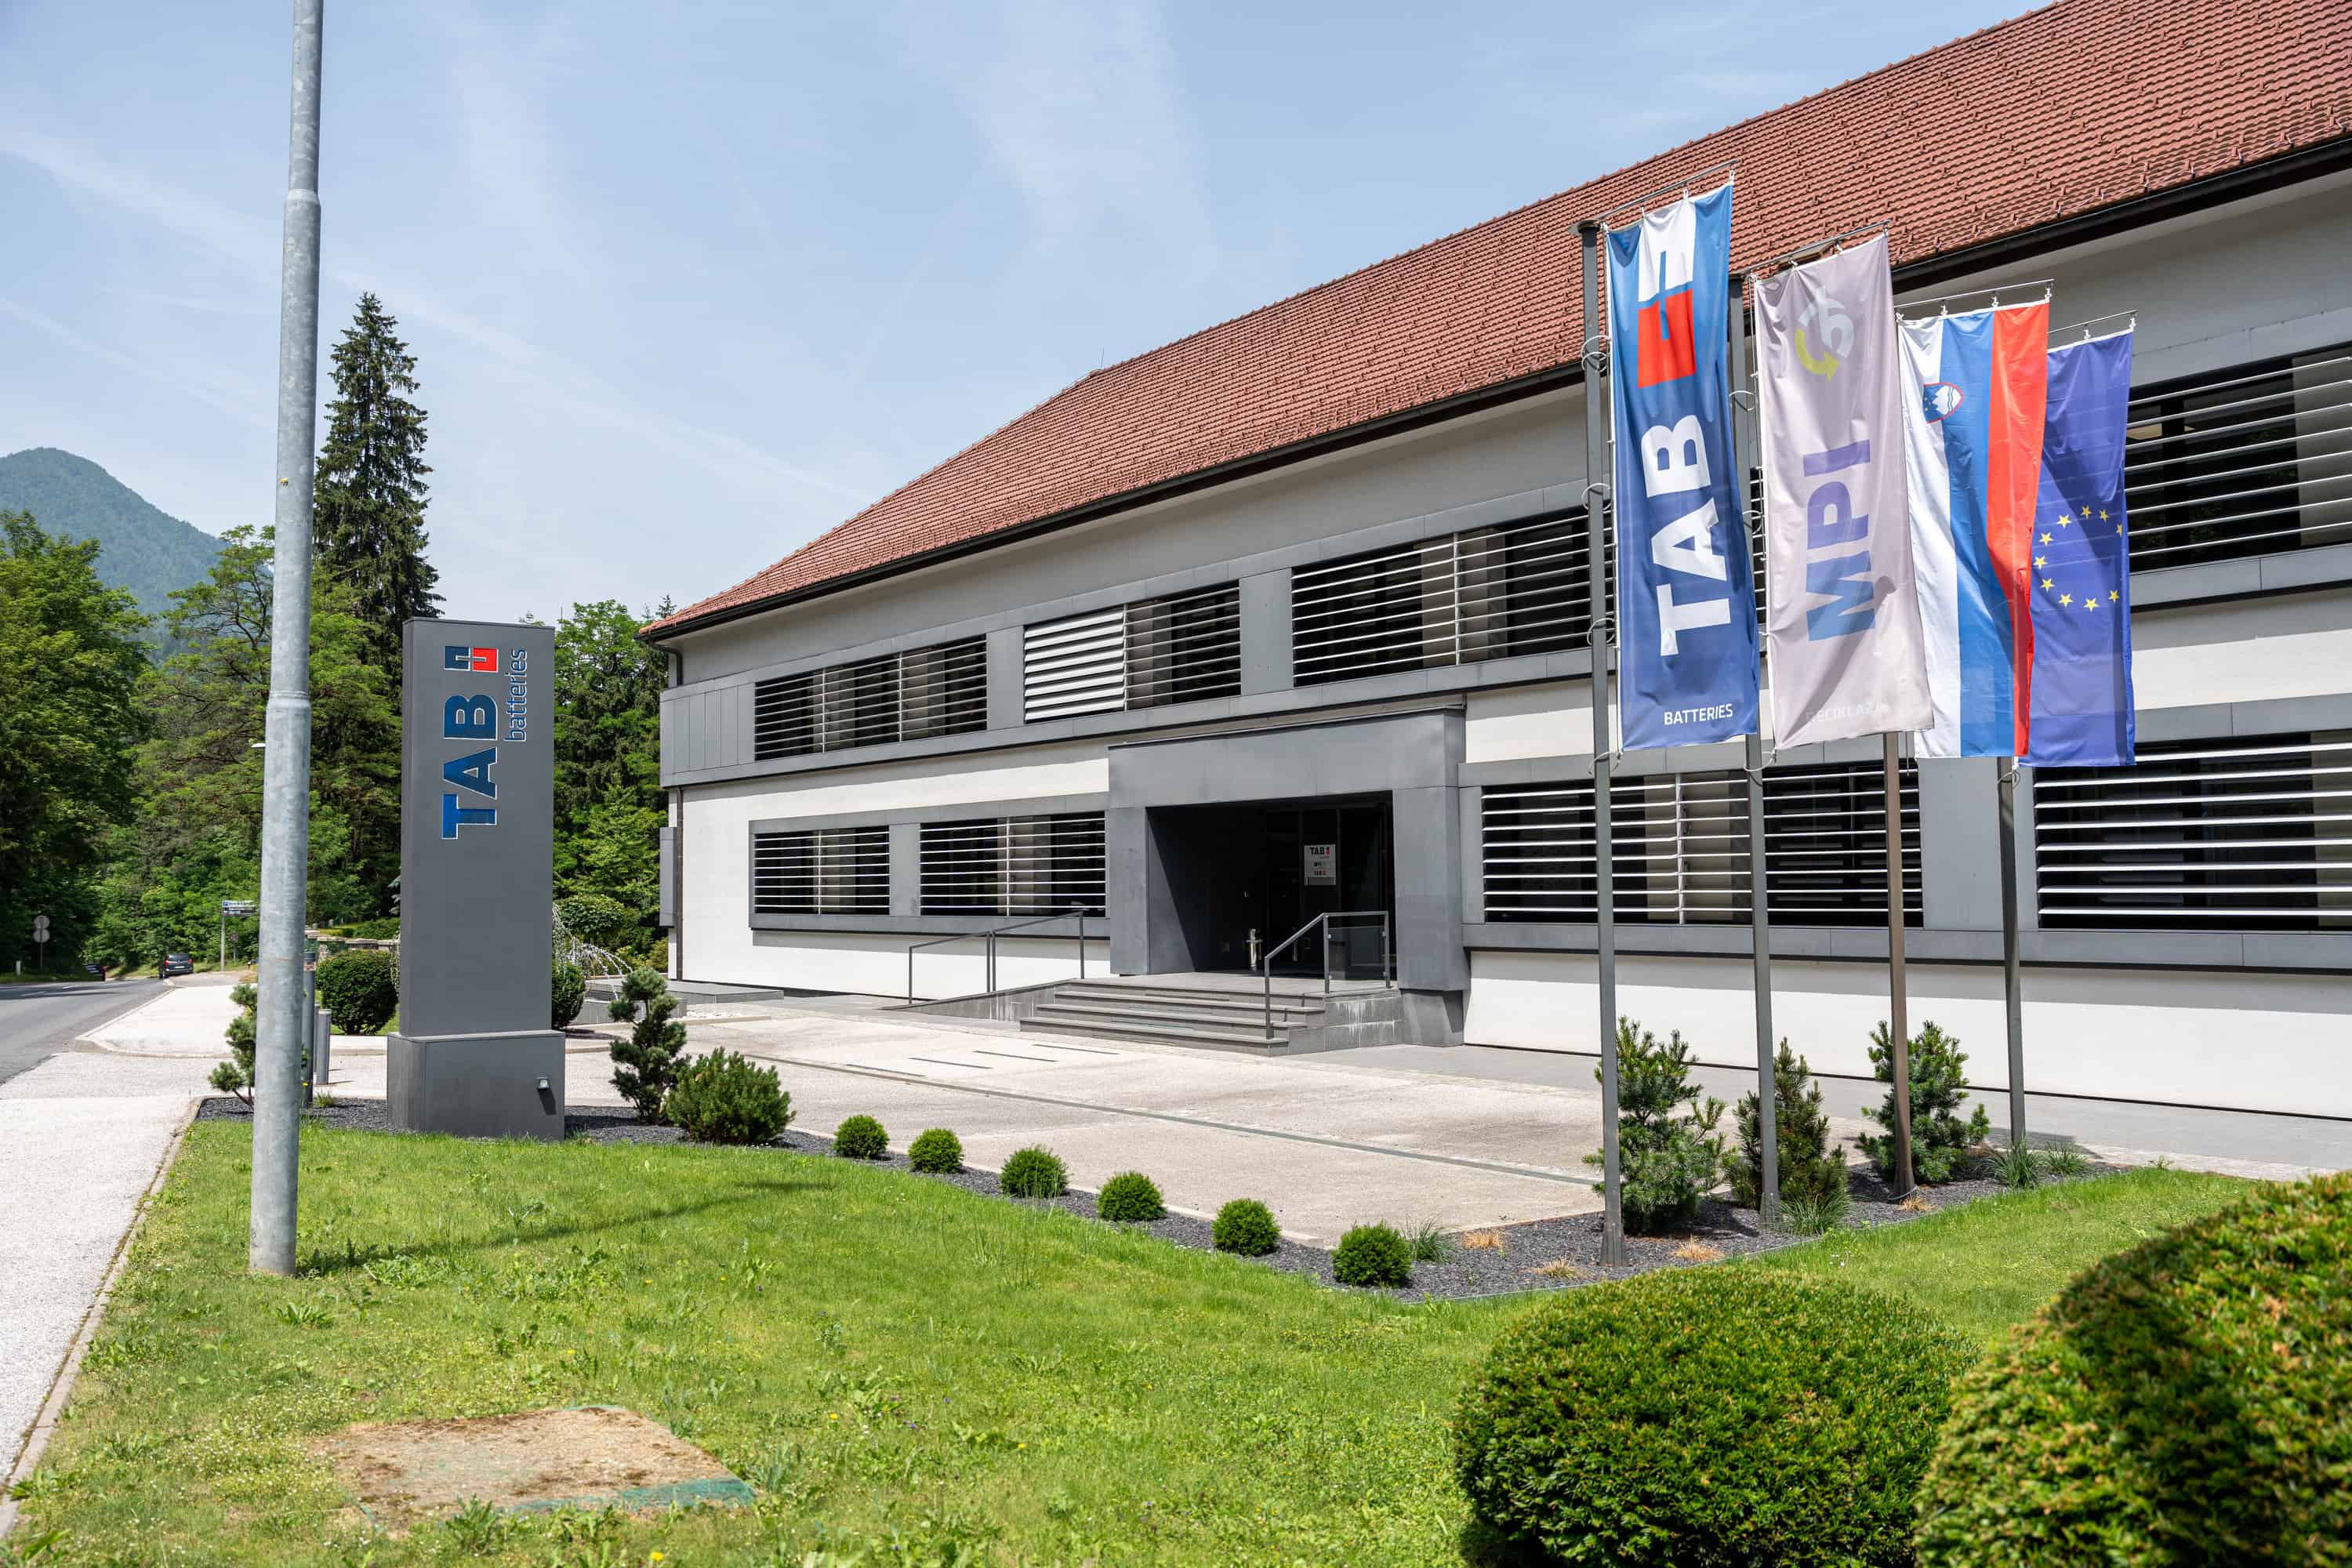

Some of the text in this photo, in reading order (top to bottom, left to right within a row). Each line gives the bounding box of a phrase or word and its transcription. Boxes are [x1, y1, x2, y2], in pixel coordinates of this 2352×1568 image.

[1641, 415, 1731, 656] TAB
[1803, 439, 1875, 641] MPI
[442, 694, 497, 840] TAB
[503, 647, 527, 742] batteries
[1664, 703, 1733, 725] BATTERIES
